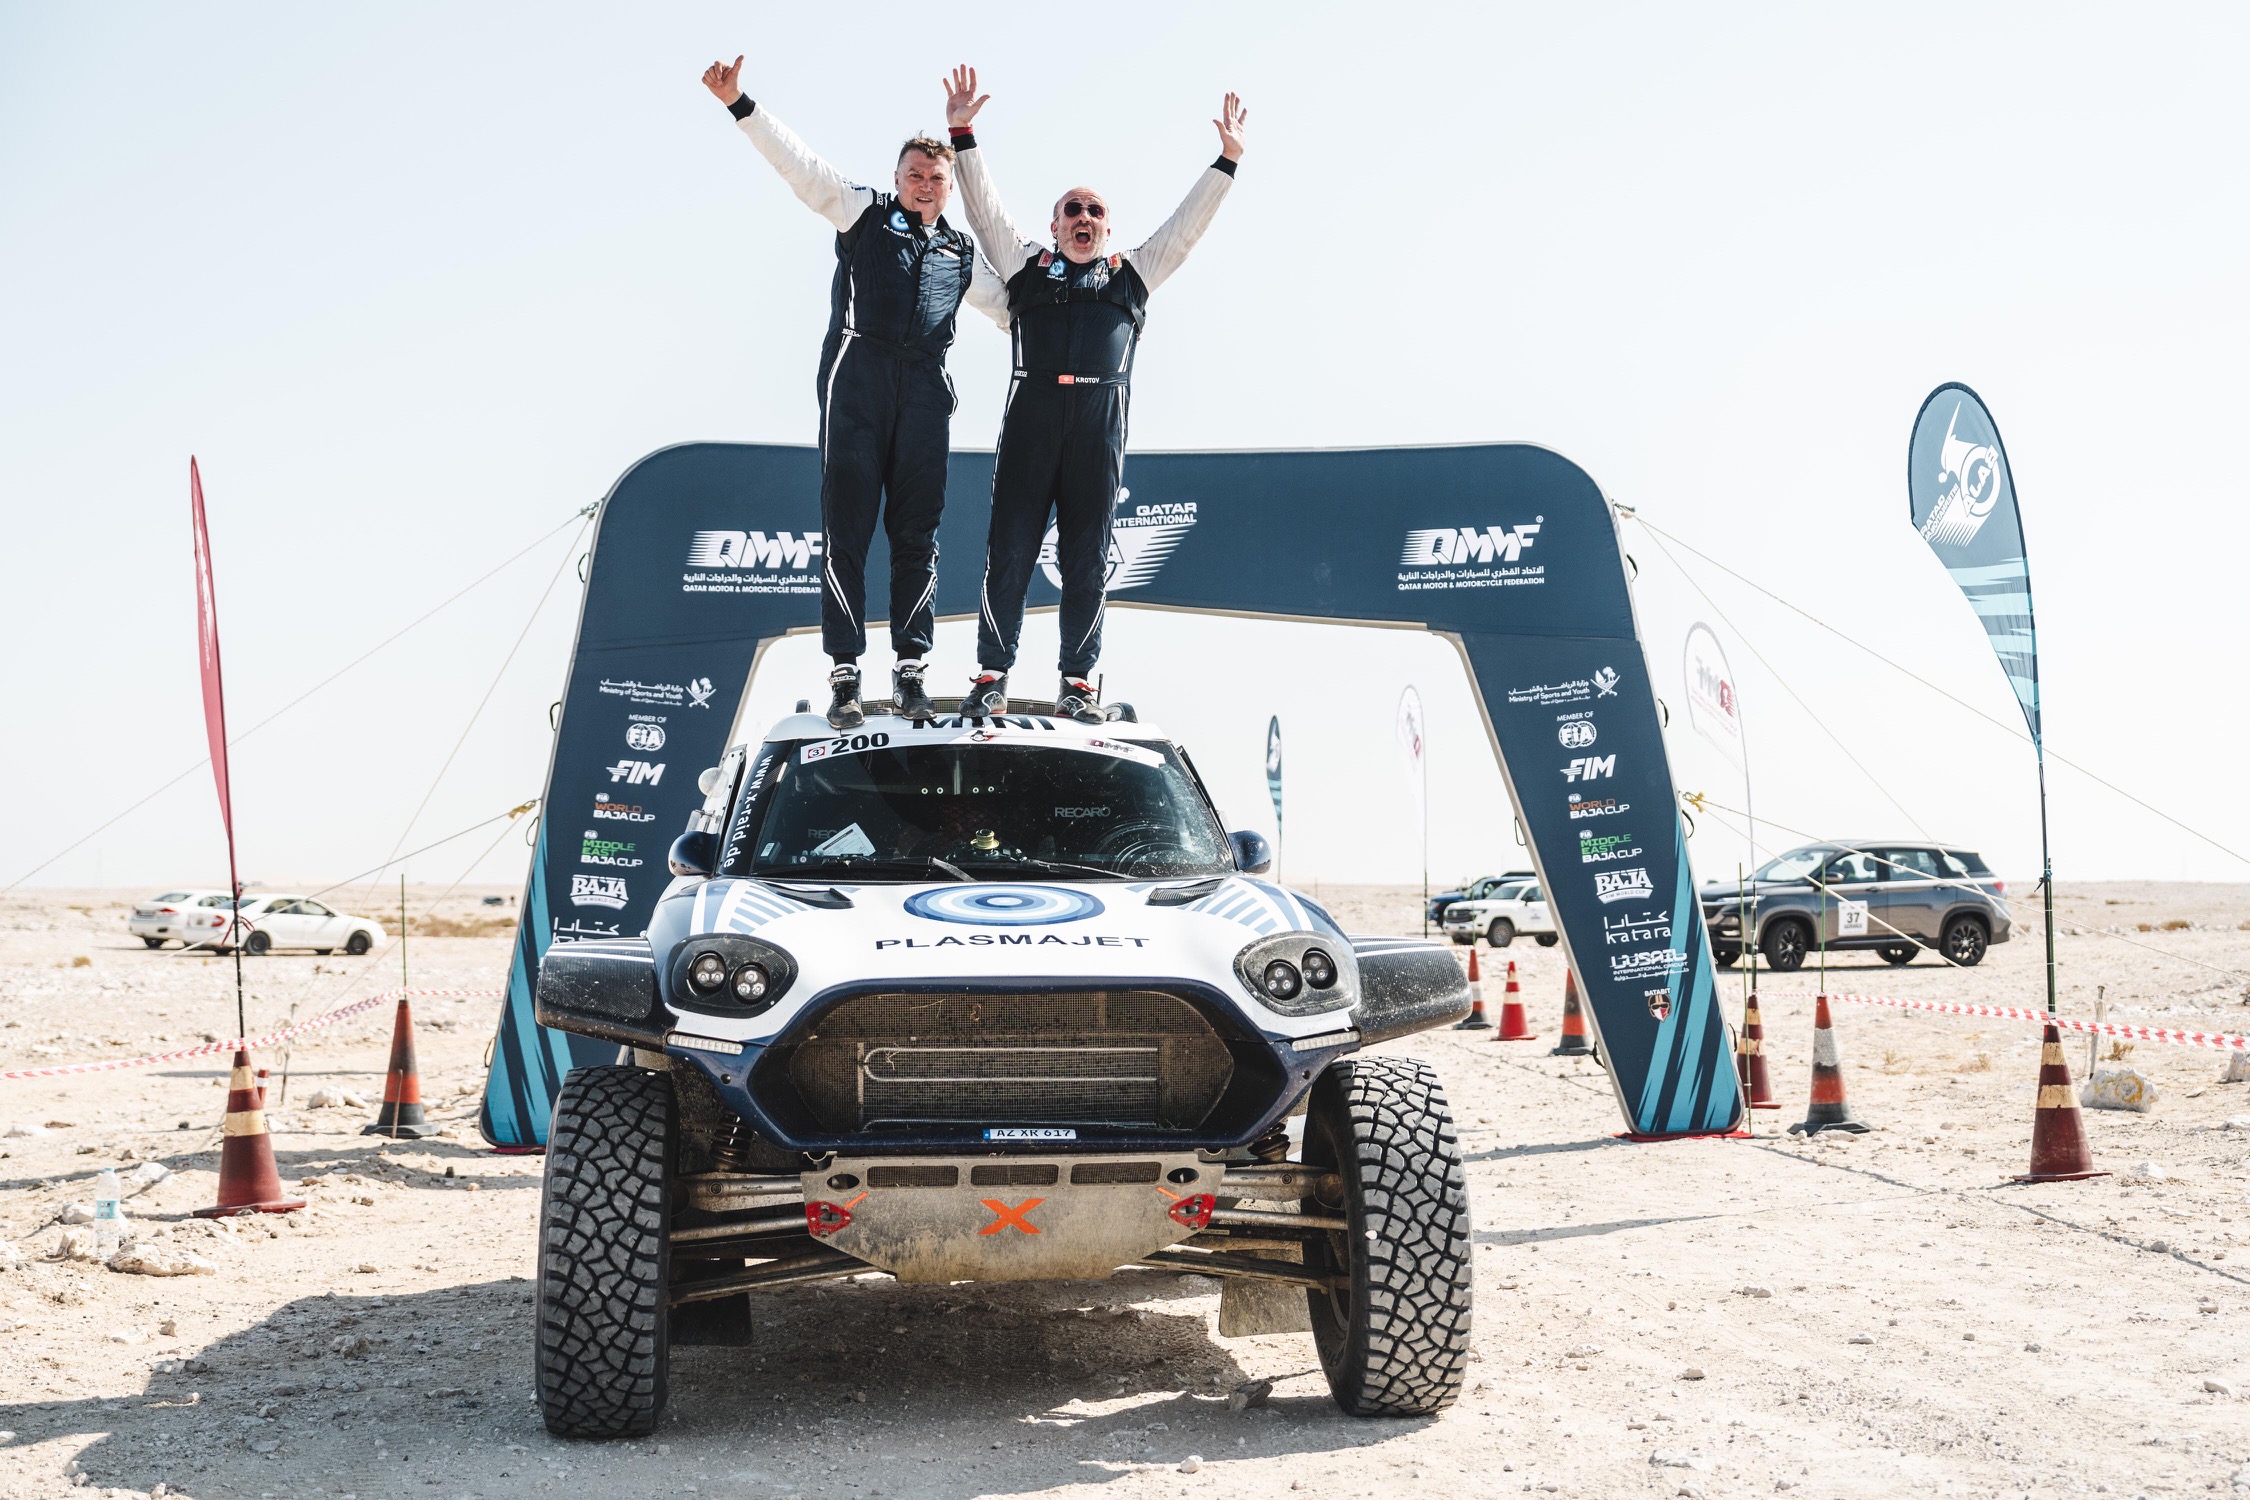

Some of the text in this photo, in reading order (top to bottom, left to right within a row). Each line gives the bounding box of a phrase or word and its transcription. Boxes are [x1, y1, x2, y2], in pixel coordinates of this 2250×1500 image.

[1136, 502, 1198, 516] QATAR
[1112, 514, 1198, 528] NTERNATIONAL
[685, 530, 822, 568] QMMF
[1400, 524, 1541, 565] QMMF
[1036, 542, 1125, 564] BA
[1398, 582, 1422, 590] QATAR
[1456, 579, 1502, 588] MOTORCYCLE
[1504, 578, 1544, 586] FEDERATION
[599, 686, 623, 696] Ministry
[632, 689, 652, 698] Sports
[1509, 695, 1533, 703] Ministry
[1540, 692, 1560, 700] Sports
[628, 714, 656, 722] MEMBER
[912, 716, 1056, 730] MINI
[1557, 713, 1583, 722] MEMBER
[628, 729, 660, 744] FIA
[1562, 726, 1594, 744] FIA
[830, 732, 890, 756] 200
[606, 760, 666, 786] FIM
[1560, 754, 1616, 783] FIM
[595, 802, 642, 814] WORLD
[724, 754, 774, 868] www.x-raid.de
[1569, 798, 1616, 811] WORLD
[593, 810, 655, 822] BAJA CUP
[1054, 806, 1111, 818] RECARO
[1570, 804, 1630, 819] BAJA CUP
[808, 828, 838, 839] REC
[583, 840, 636, 851] MIDDLE
[1580, 834, 1632, 847] MIDDLE
[582, 848, 617, 857] EAST
[1582, 844, 1616, 855] EAST
[1582, 848, 1642, 863] BAJA CUP
[581, 855, 643, 867] BAJA CUP
[570, 874, 629, 901] BAJA
[1594, 868, 1654, 896] BAJA
[1847, 912, 1860, 923] 37
[1606, 926, 1671, 944] katara
[875, 934, 1150, 950] PLASMAJET
[1613, 964, 1663, 975] INTERNATIONAL
[1644, 988, 1671, 997] BATABIT
